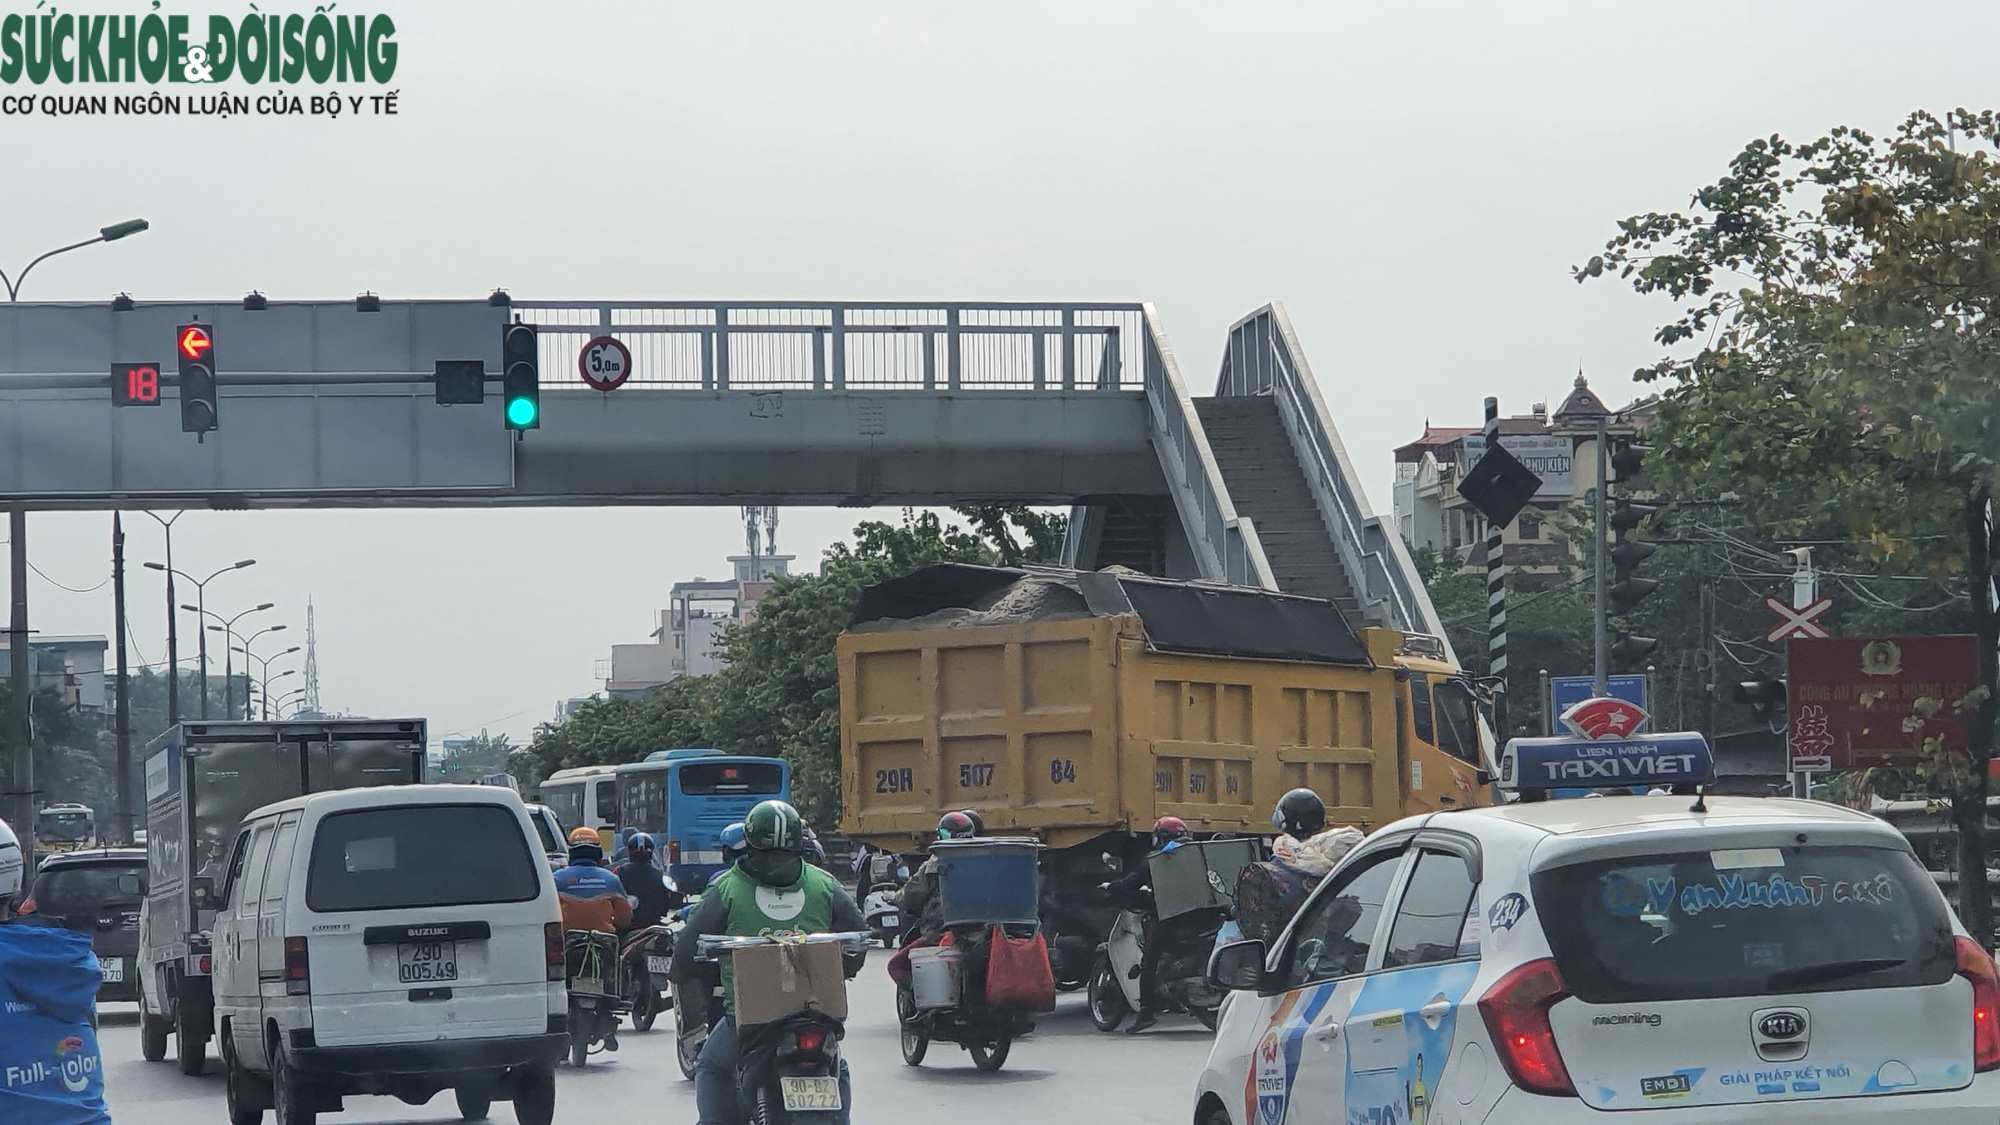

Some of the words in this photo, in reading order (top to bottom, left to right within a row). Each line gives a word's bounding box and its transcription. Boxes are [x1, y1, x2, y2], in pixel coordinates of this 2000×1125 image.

[128, 366, 158, 401] 18
[1618, 743, 1658, 756] MINH
[876, 768, 914, 794] 29H
[960, 762, 995, 788] 507
[1051, 758, 1076, 785] 84
[1491, 898, 1521, 926] 234
[407, 927, 449, 937] SUZUKI
[401, 962, 455, 980] 005.49
[1592, 1012, 1662, 1027] morning
[1766, 1019, 1799, 1034] KIA
[1754, 1068, 1791, 1082] PHÁP
